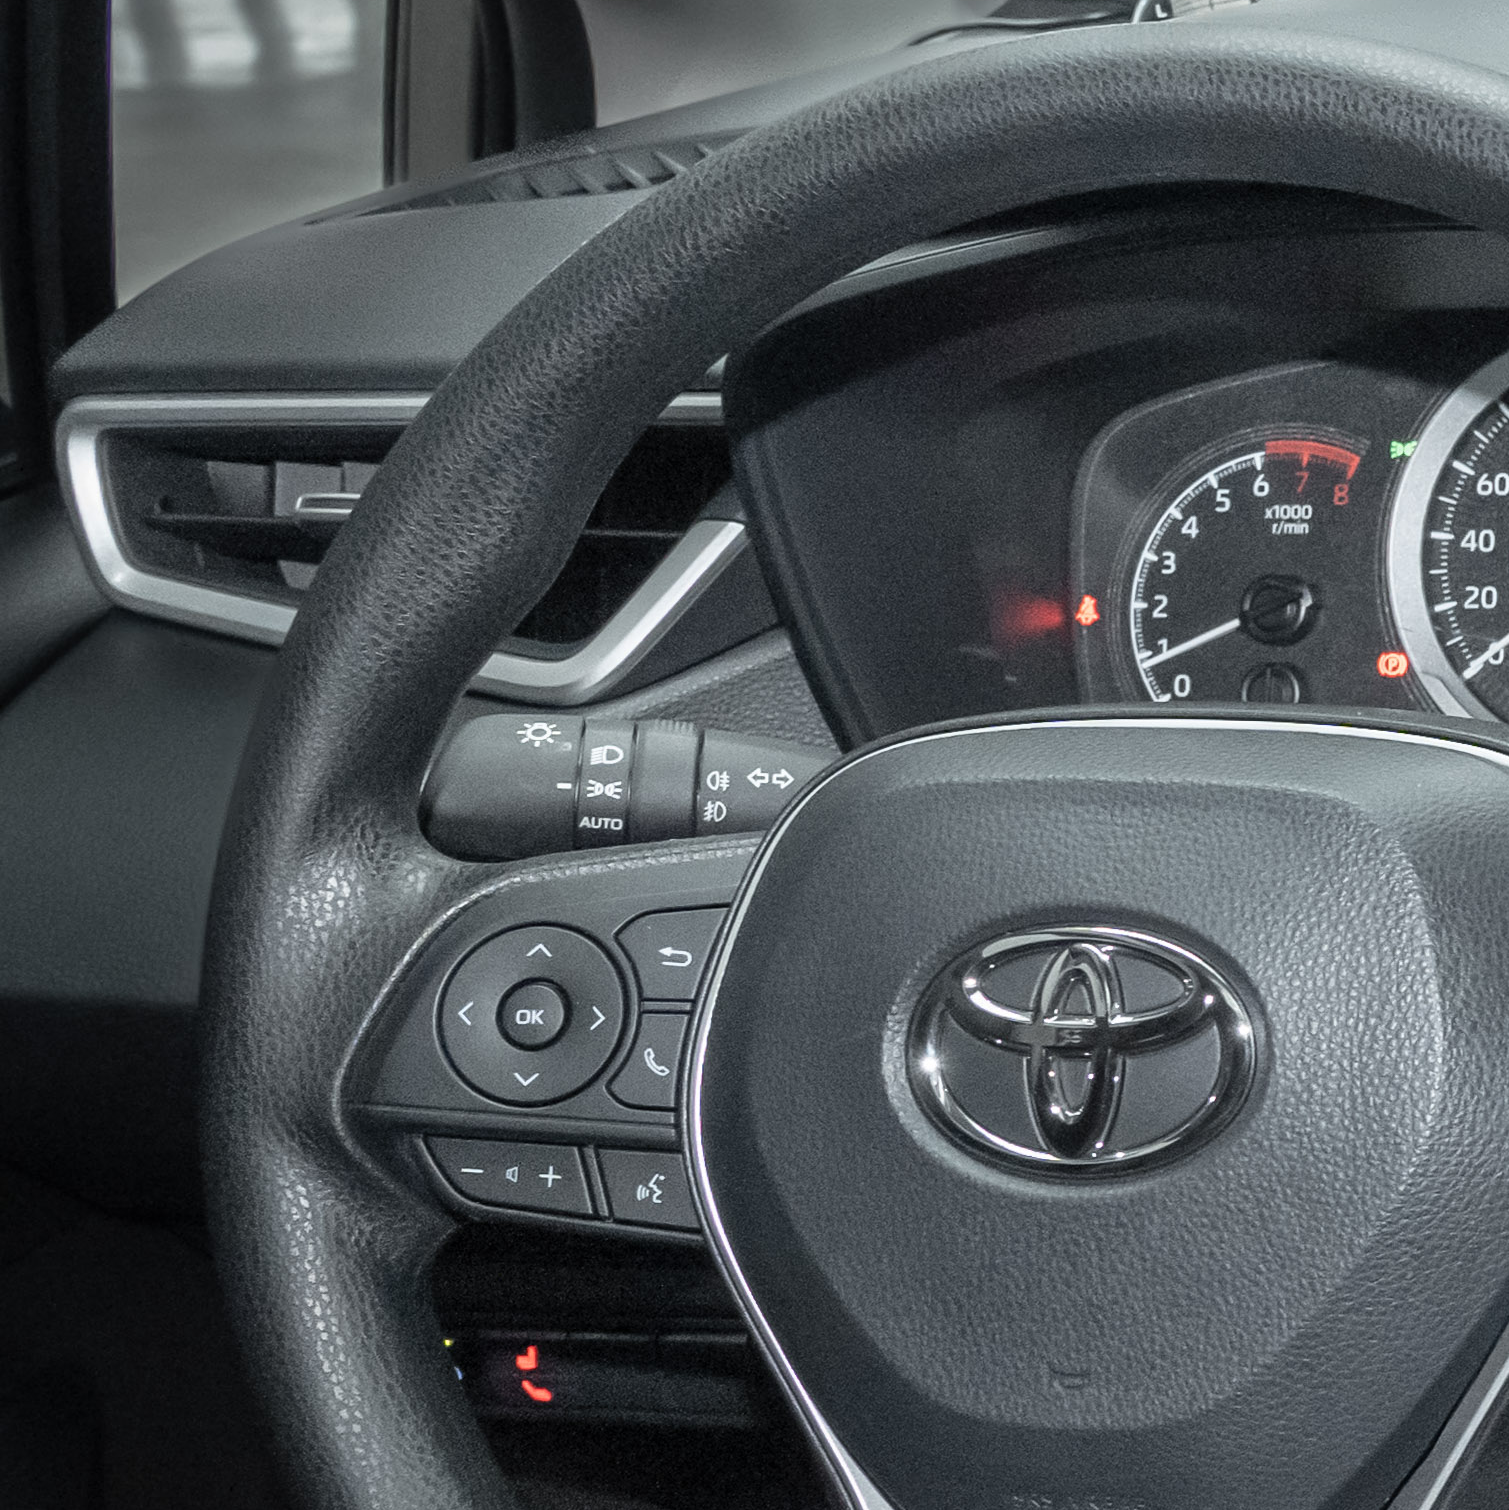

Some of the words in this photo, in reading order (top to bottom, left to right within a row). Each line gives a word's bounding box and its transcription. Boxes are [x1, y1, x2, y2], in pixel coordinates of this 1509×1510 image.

[1253, 474, 1270, 498] 6
[1295, 472, 1309, 493] 7
[1333, 484, 1350, 505] 8
[1215, 489, 1231, 513] 5
[1181, 516, 1199, 539] 4
[1271, 521, 1310, 535] r/min
[1460, 528, 1496, 553] 40
[1161, 551, 1177, 575] 3
[1152, 595, 1169, 619] 2
[1463, 585, 1498, 610] 20
[1173, 674, 1191, 698] 0
[579, 814, 624, 832] AUTO
[515, 1008, 545, 1027] OK
